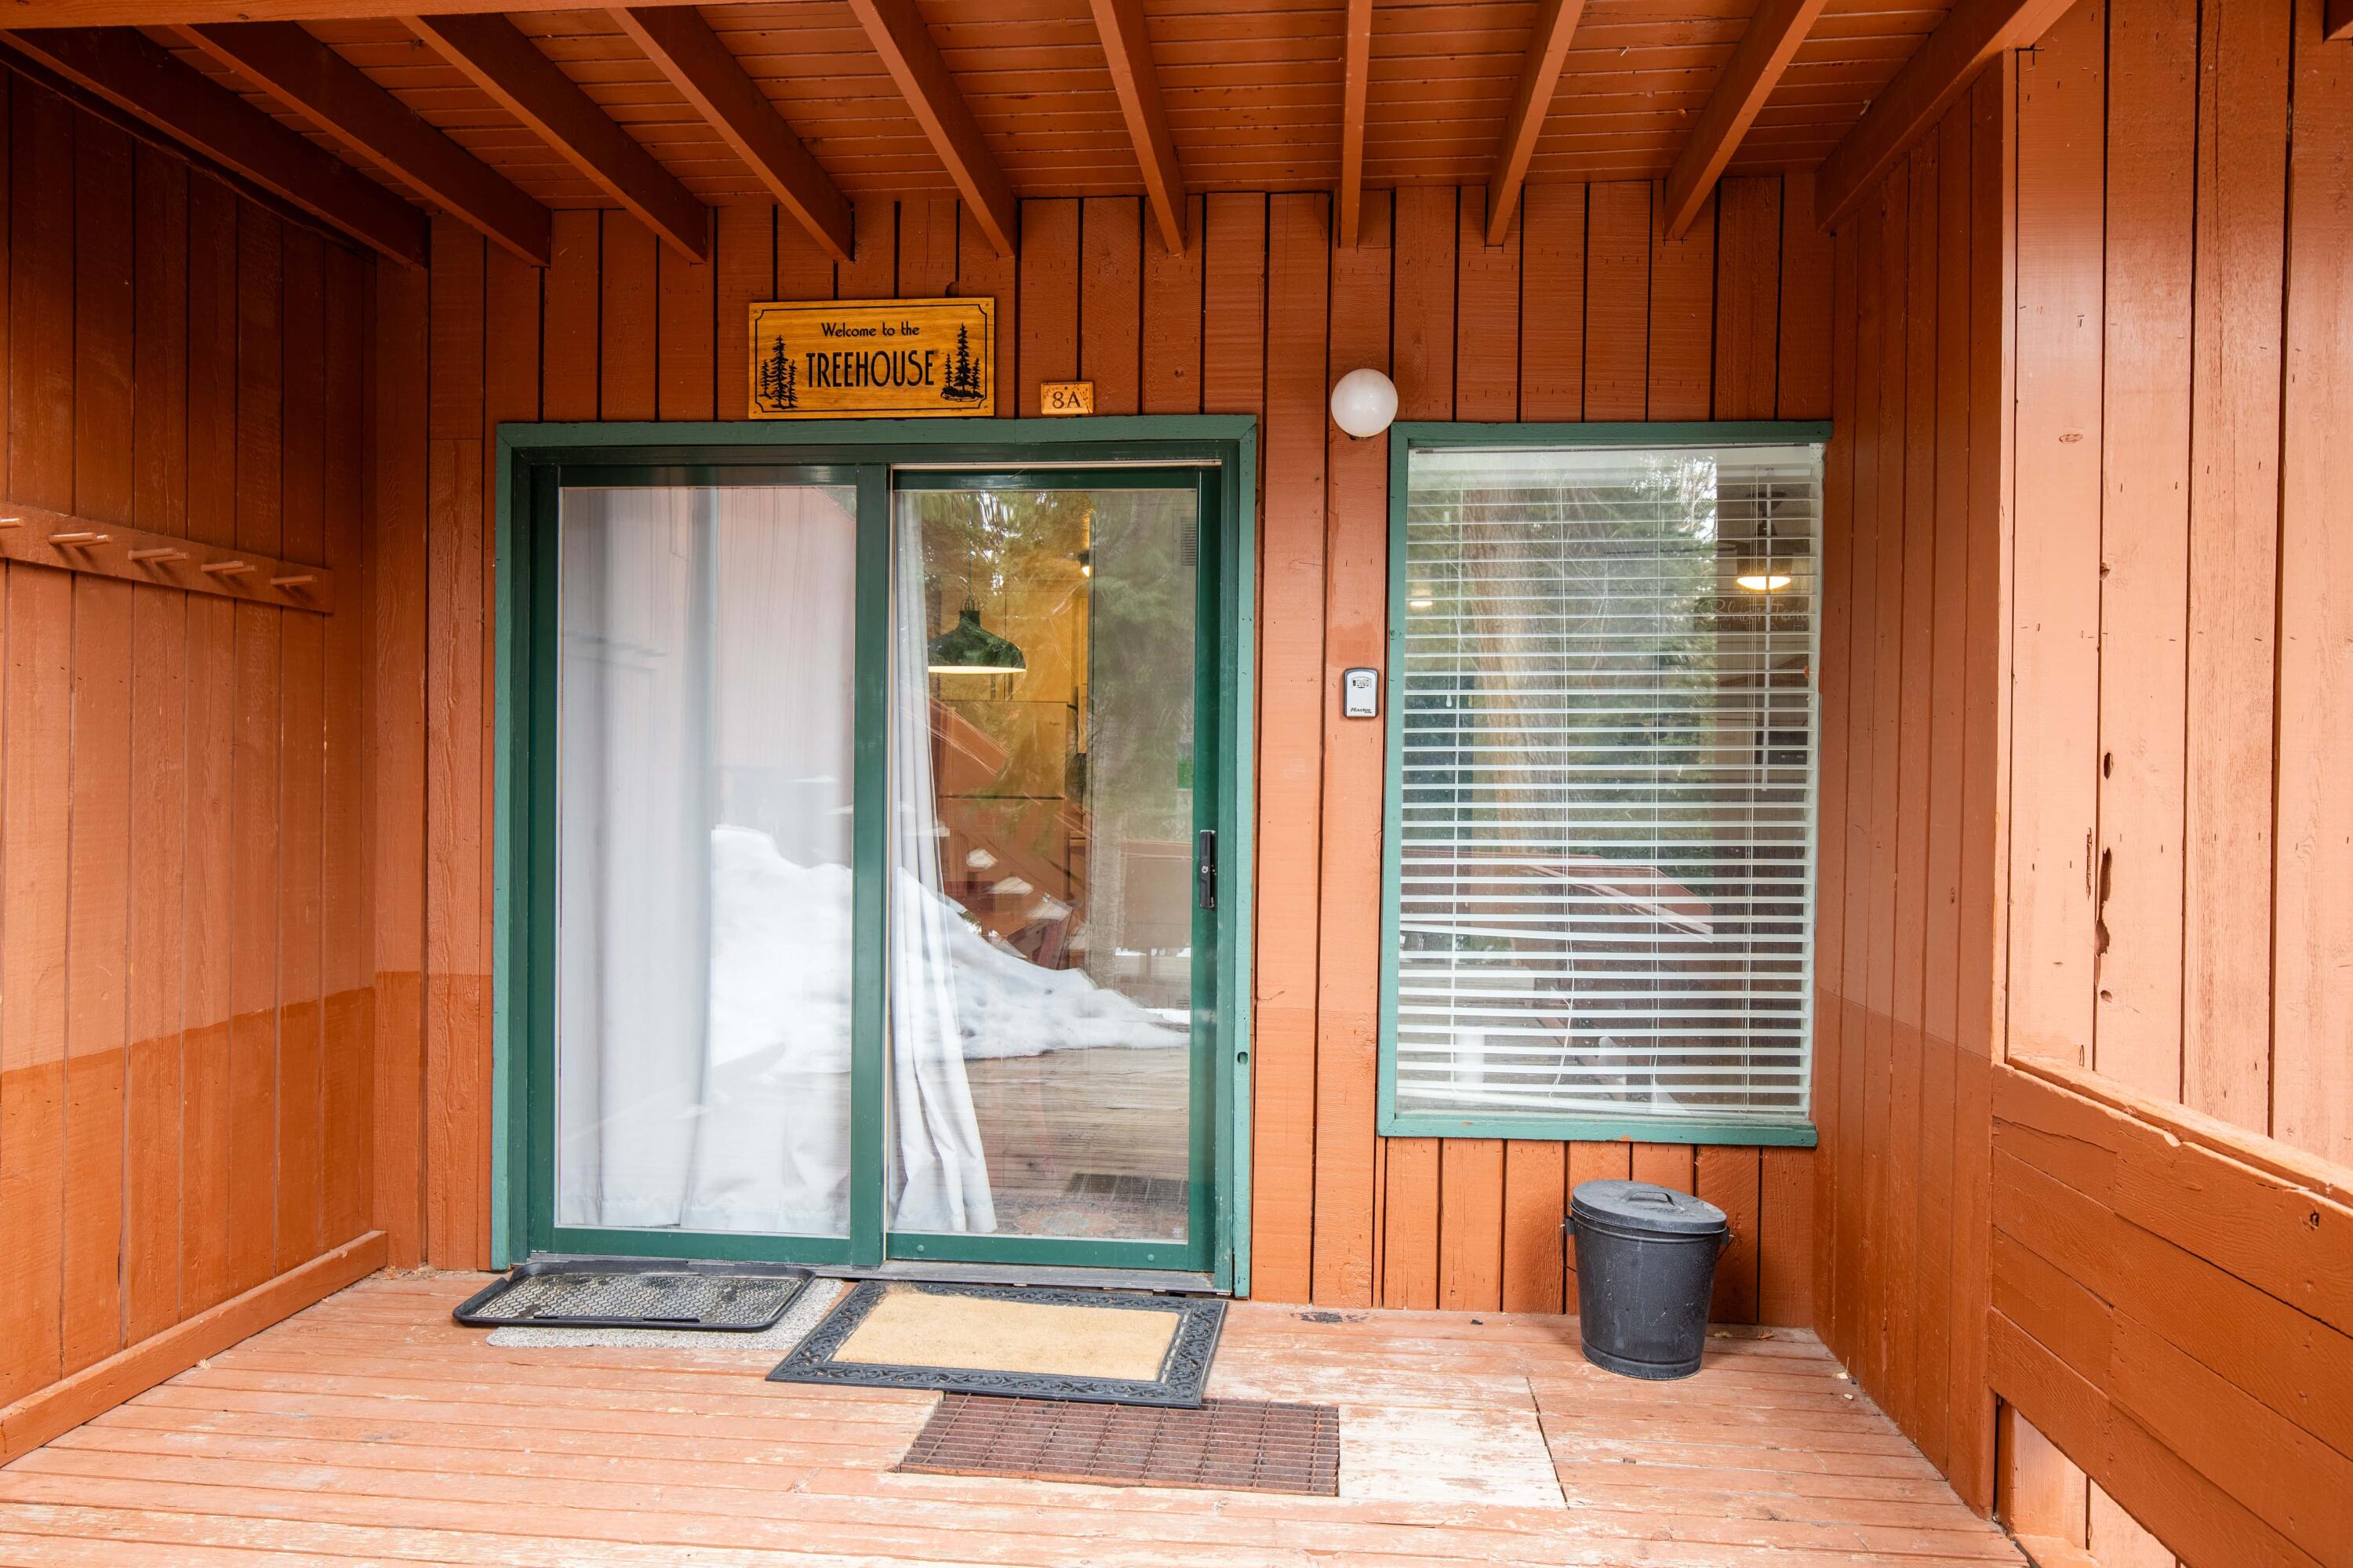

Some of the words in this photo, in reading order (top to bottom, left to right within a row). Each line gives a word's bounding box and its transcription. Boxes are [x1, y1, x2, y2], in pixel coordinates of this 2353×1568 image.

[820, 322, 877, 338] Welcome
[882, 322, 895, 337] to
[900, 320, 920, 336] the
[806, 350, 935, 387] TREEHOUSE
[1053, 391, 1082, 409] 8A
